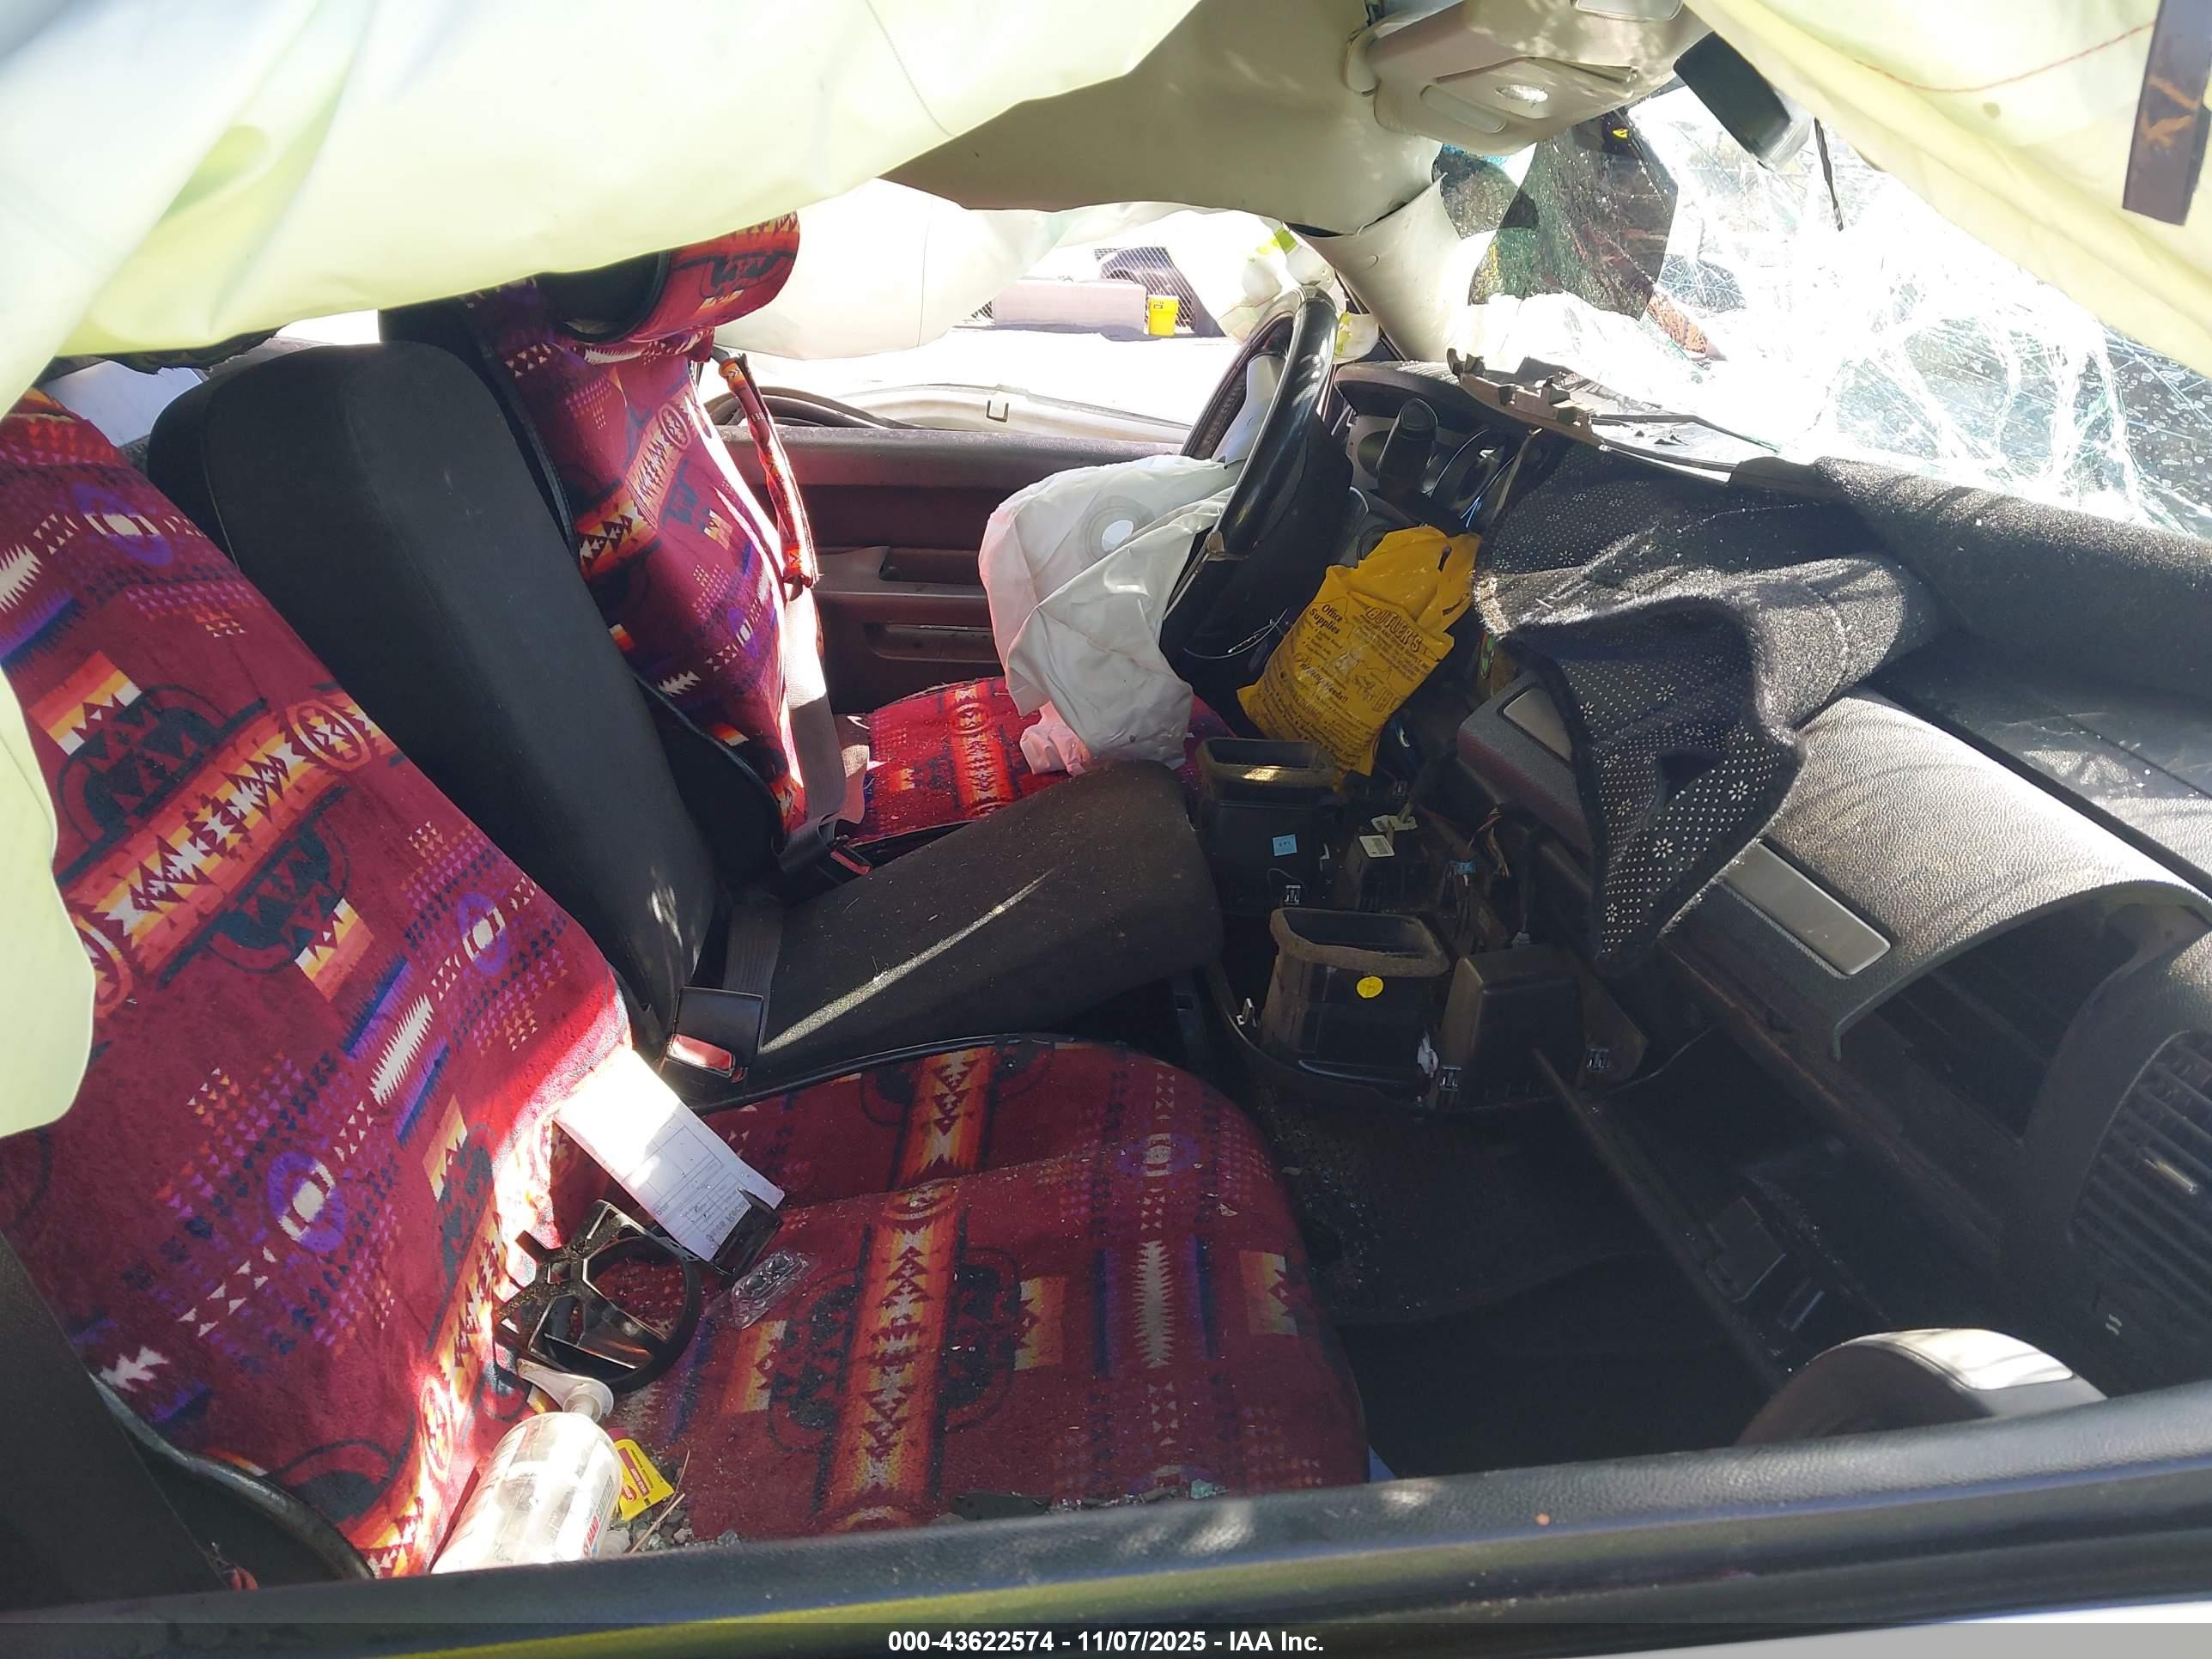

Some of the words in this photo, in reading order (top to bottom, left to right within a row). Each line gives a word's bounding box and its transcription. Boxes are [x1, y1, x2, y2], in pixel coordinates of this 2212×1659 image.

[1309, 607, 1340, 635] Supplies
[1321, 603, 1344, 623] Office
[1364, 605, 1424, 653] BUTLER'S
[586, 1514, 599, 1547] HAND
